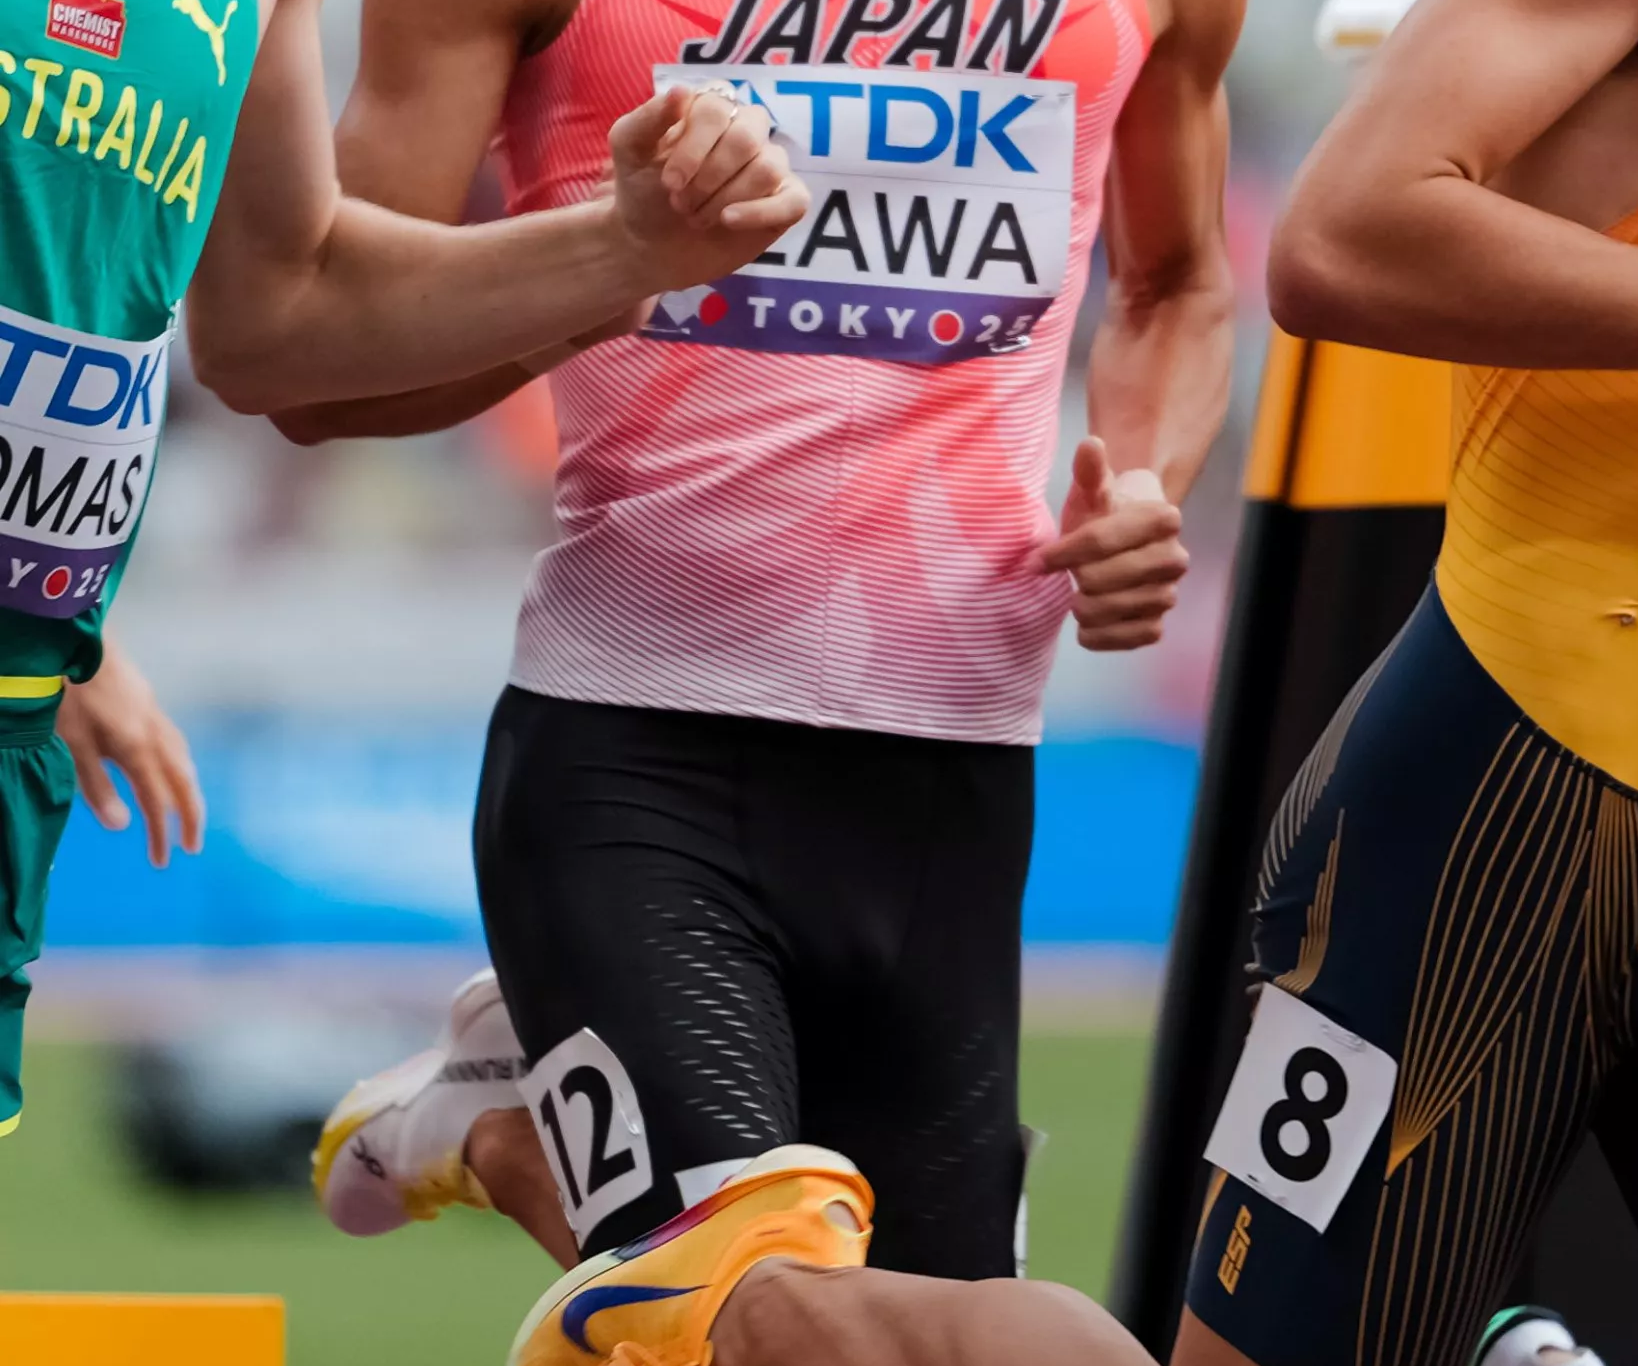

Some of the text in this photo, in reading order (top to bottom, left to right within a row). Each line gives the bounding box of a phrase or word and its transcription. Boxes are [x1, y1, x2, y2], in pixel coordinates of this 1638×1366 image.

[53, 3, 121, 40] CHEMIST
[776, 80, 1039, 174] TDK
[752, 188, 1038, 286] AWA
[540, 1064, 637, 1212] 12
[1260, 1046, 1348, 1183] 8
[1217, 1204, 1252, 1296] ESP
